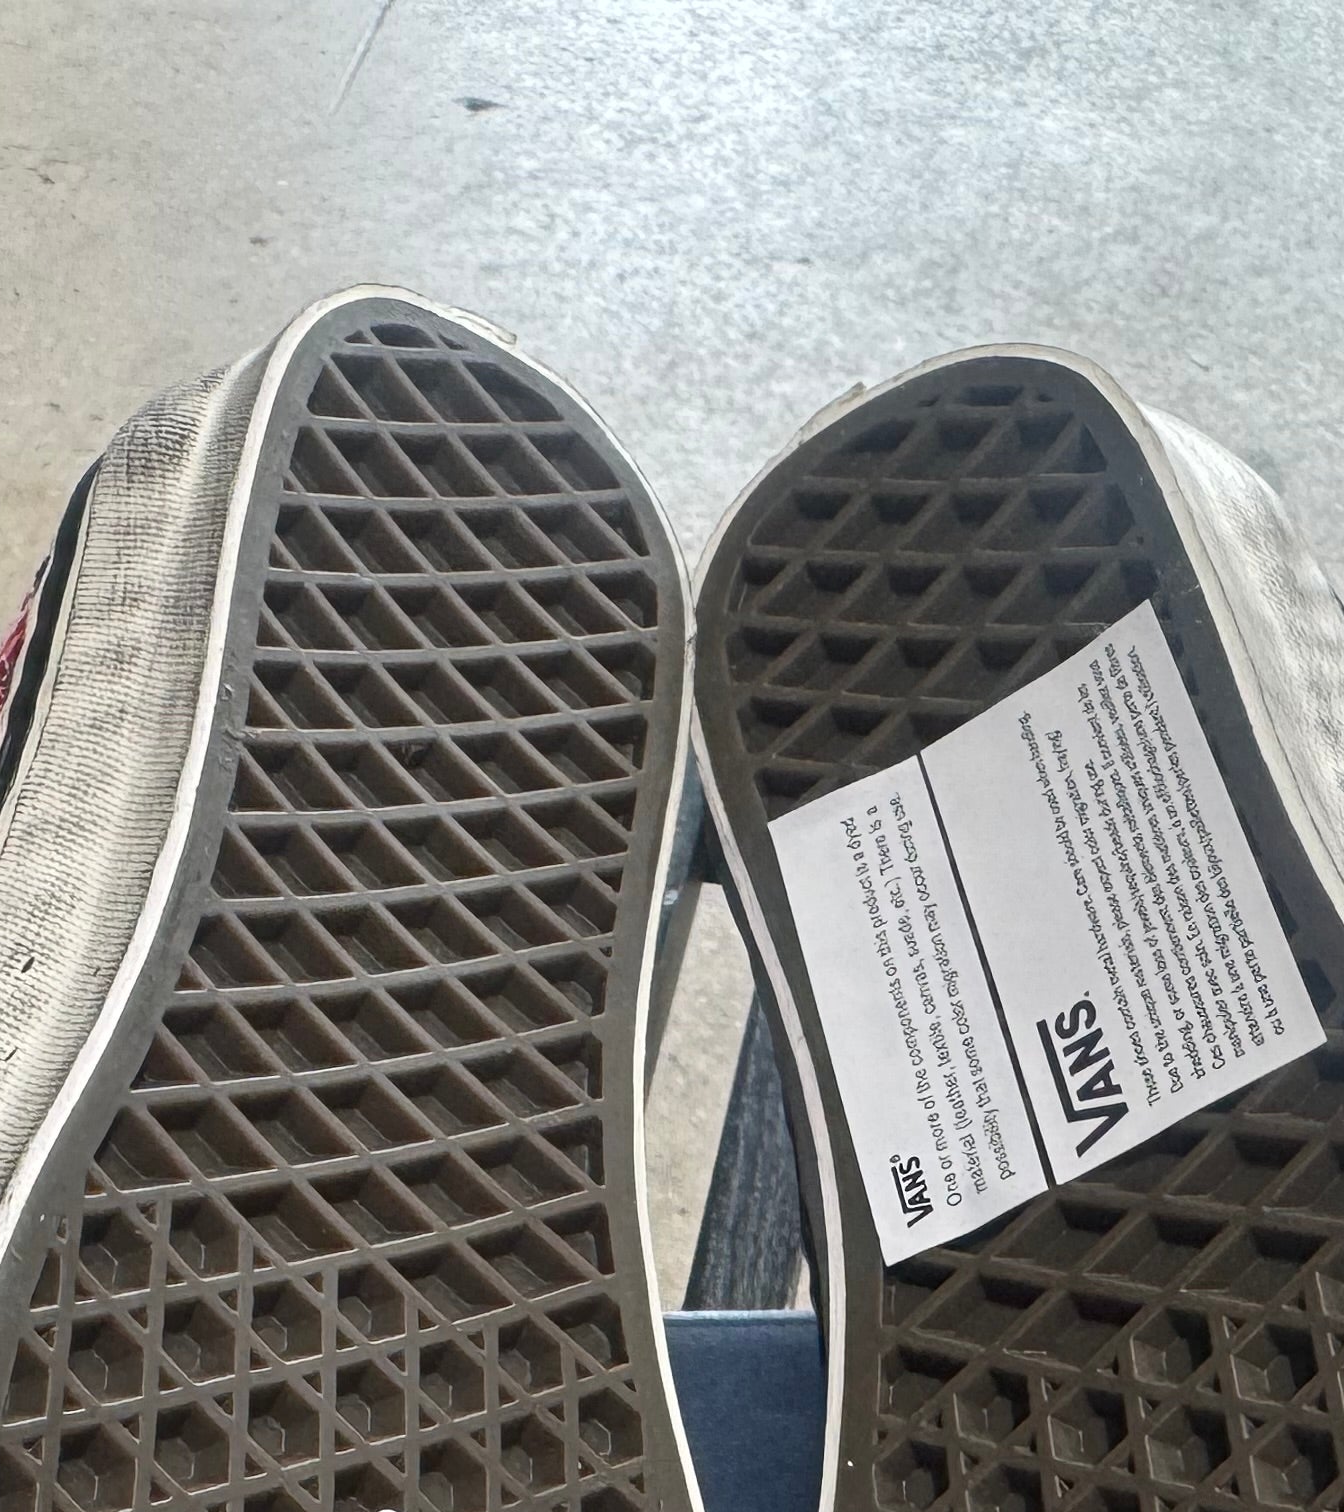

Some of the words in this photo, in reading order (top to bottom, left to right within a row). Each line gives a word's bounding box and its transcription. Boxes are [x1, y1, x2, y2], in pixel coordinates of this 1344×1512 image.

[865, 804, 878, 816] a
[867, 819, 882, 834] is
[839, 816, 862, 849] dyed
[852, 850, 864, 861] a
[874, 834, 894, 876] There
[909, 865, 930, 901] occur
[858, 875, 888, 928] product
[923, 902, 940, 932] may
[873, 929, 891, 957] this
[882, 956, 897, 976] on
[930, 932, 959, 998] migration
[887, 977, 924, 1066] components
[949, 999, 970, 1035] color
[961, 1035, 983, 1076] some
[914, 1068, 931, 1094] the
[971, 1076, 991, 1108] that
[1035, 992, 1129, 1158] VANS
[916, 1094, 935, 1109] of
[942, 1065, 973, 1130] (leather,
[926, 1112, 948, 1151] more
[981, 1108, 1016, 1180] possibility
[938, 1154, 953, 1170] or
[958, 1132, 988, 1195] material
[943, 1172, 962, 1206] One
